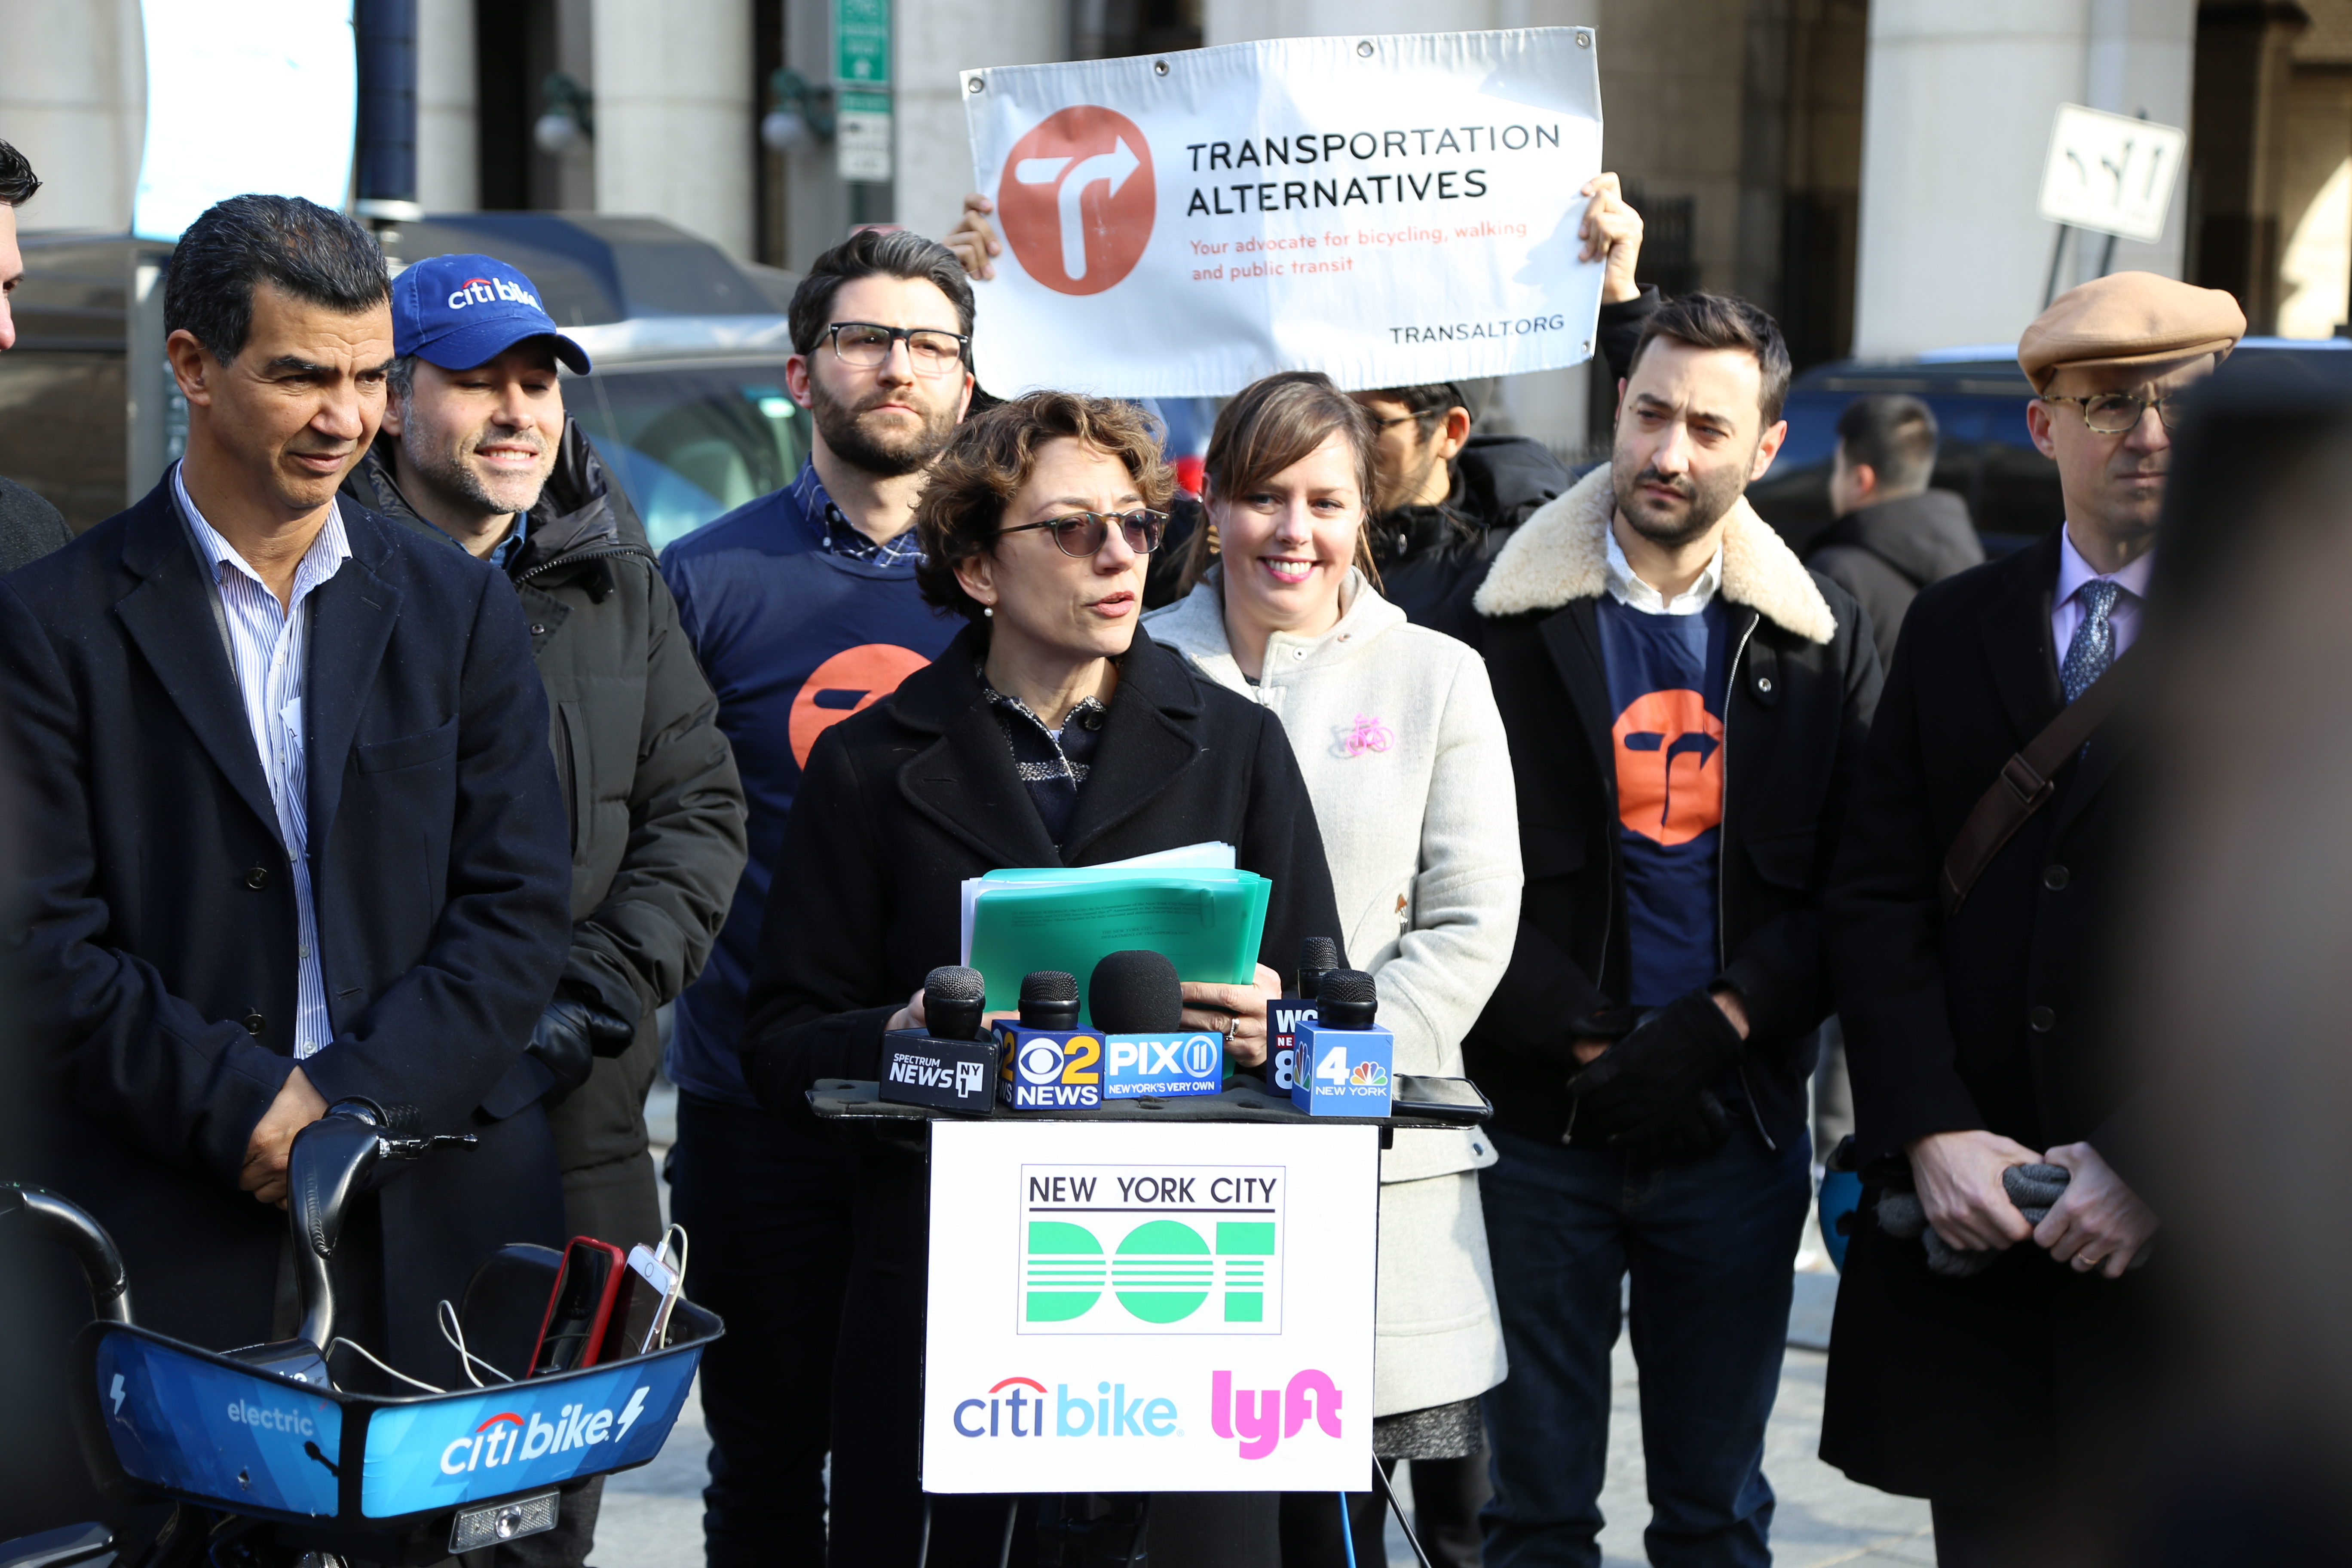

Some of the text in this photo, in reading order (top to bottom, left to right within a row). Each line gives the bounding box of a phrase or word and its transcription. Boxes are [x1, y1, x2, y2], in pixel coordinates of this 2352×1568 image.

[1187, 124, 1560, 171] TRANSPORTATION
[1188, 169, 1487, 216] ALTERNATIVES
[1190, 221, 1527, 256] Your advocate for bicycling, walking
[1192, 257, 1354, 282] and public transit
[448, 278, 496, 309] citi
[1389, 314, 1565, 344] TRANSALT.ORG
[893, 1053, 940, 1067] SPECTRUM
[1001, 1031, 1015, 1082] 2
[1061, 1035, 1100, 1084] 2
[1109, 1041, 1183, 1076] PIX
[1316, 1046, 1350, 1085] 4
[889, 1062, 981, 1088] NEWS NY
[1109, 1081, 1215, 1094] NEW YORK'S VERY OWN
[1315, 1086, 1387, 1097] NEW YORK
[1017, 1085, 1099, 1106] NEWS
[1030, 1176, 1277, 1204] NEW YORK CITY
[1026, 1220, 1275, 1324] DOT
[227, 1399, 313, 1436] electric
[953, 1377, 1048, 1438] citi
[1211, 1369, 1342, 1460] lyft
[440, 1412, 524, 1475] citi
